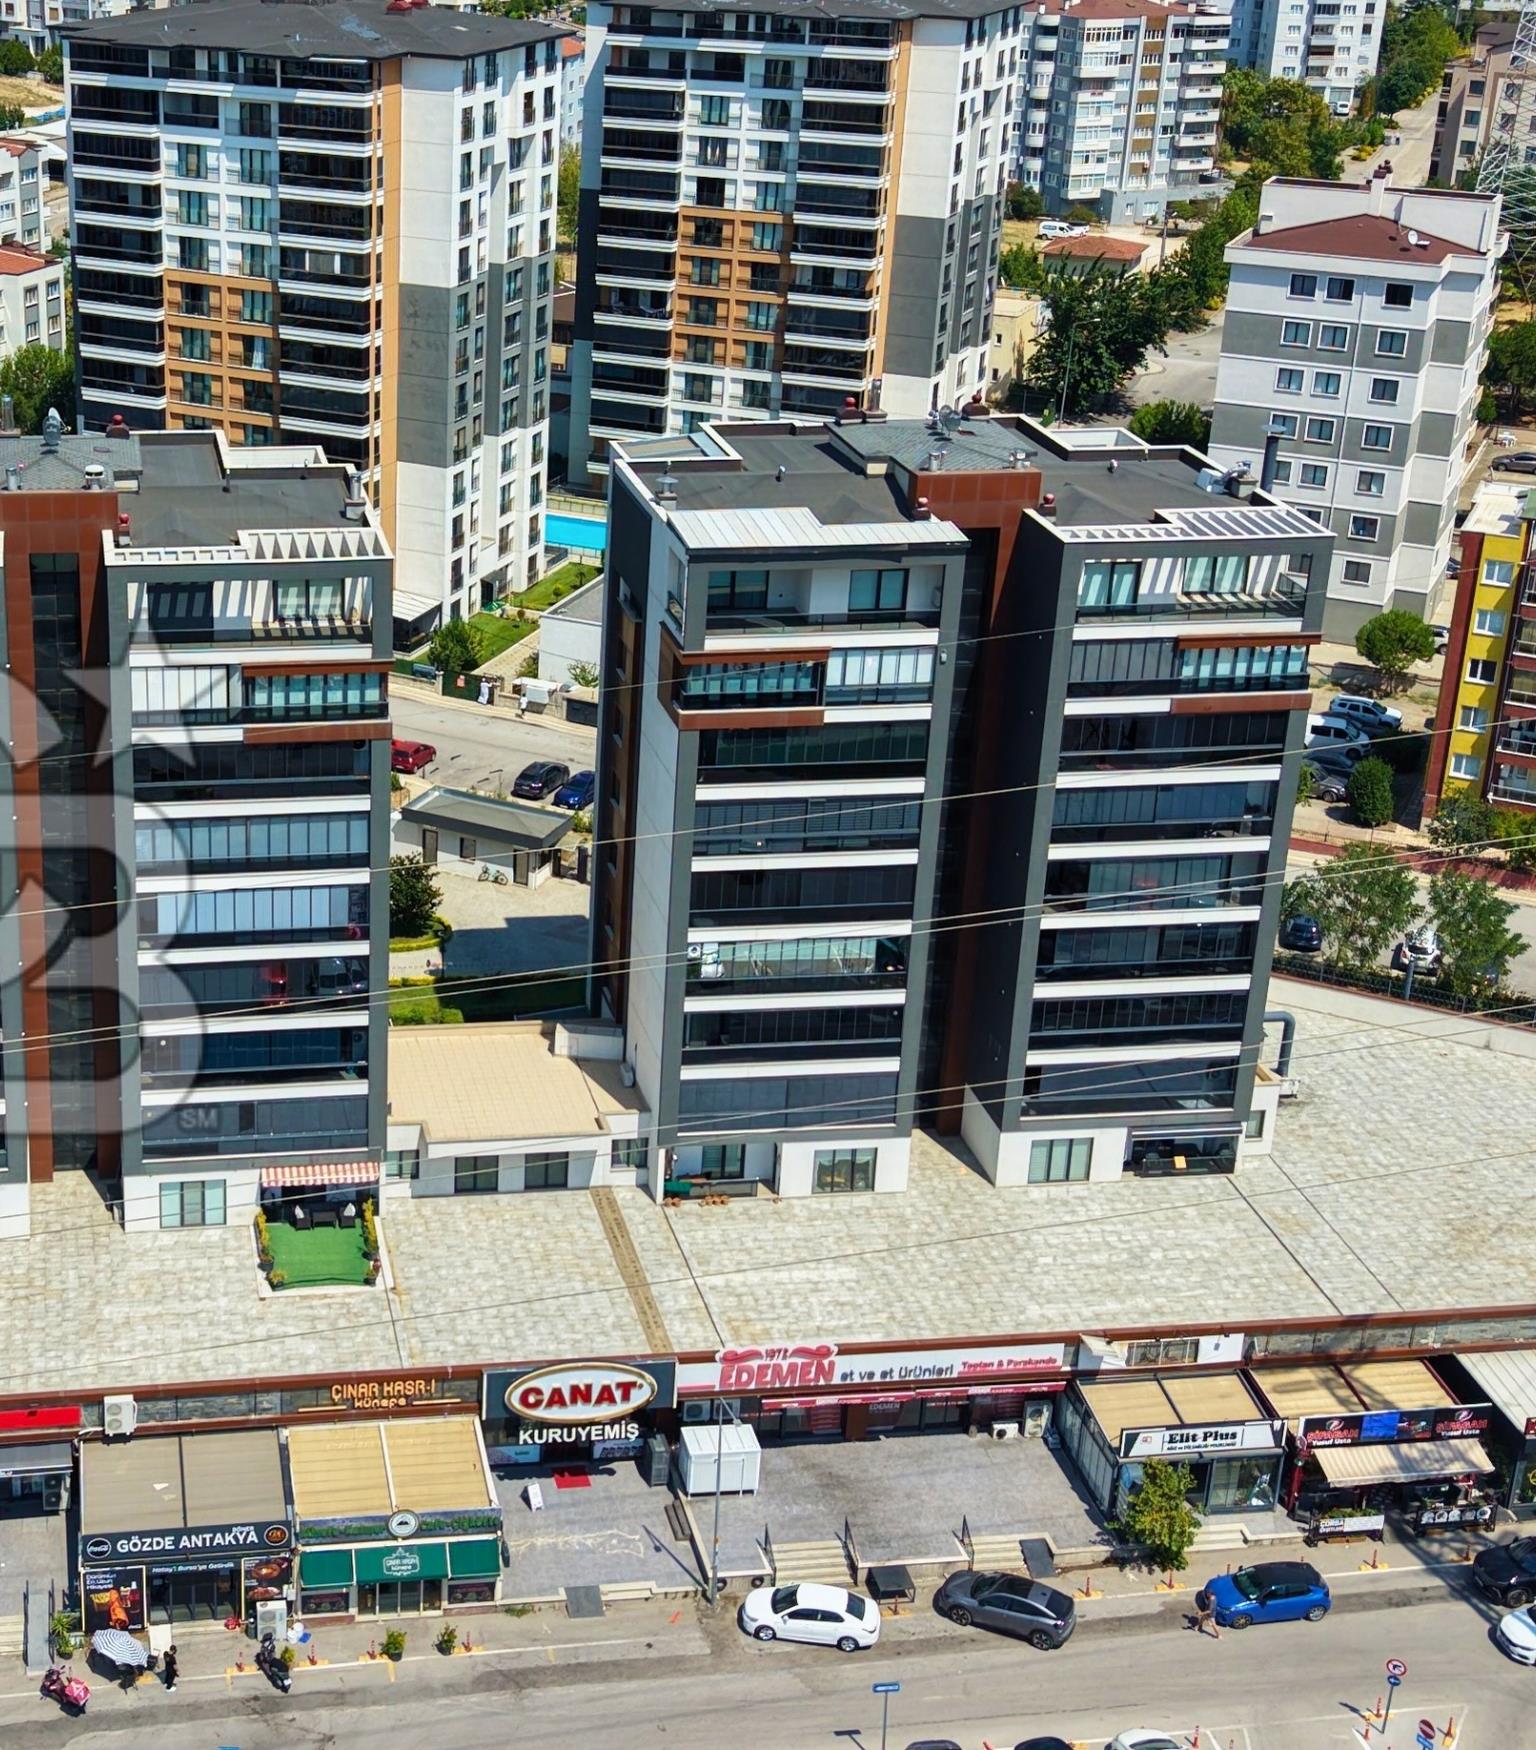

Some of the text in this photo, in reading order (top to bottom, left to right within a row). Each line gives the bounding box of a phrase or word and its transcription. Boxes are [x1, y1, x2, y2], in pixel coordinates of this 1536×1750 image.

[718, 1359, 836, 1390] EDEMEN
[840, 1369, 854, 1382] et
[859, 1370, 875, 1381] ve
[880, 1368, 894, 1380] et
[331, 1382, 379, 1402] ÇINAR
[519, 1381, 638, 1410] CANAT
[519, 1421, 640, 1445] KURUYEMİŞ
[1167, 1429, 1238, 1444] Elit Plus
[117, 1534, 175, 1554] GÖZDE
[179, 1531, 259, 1550] ANTAKYA
